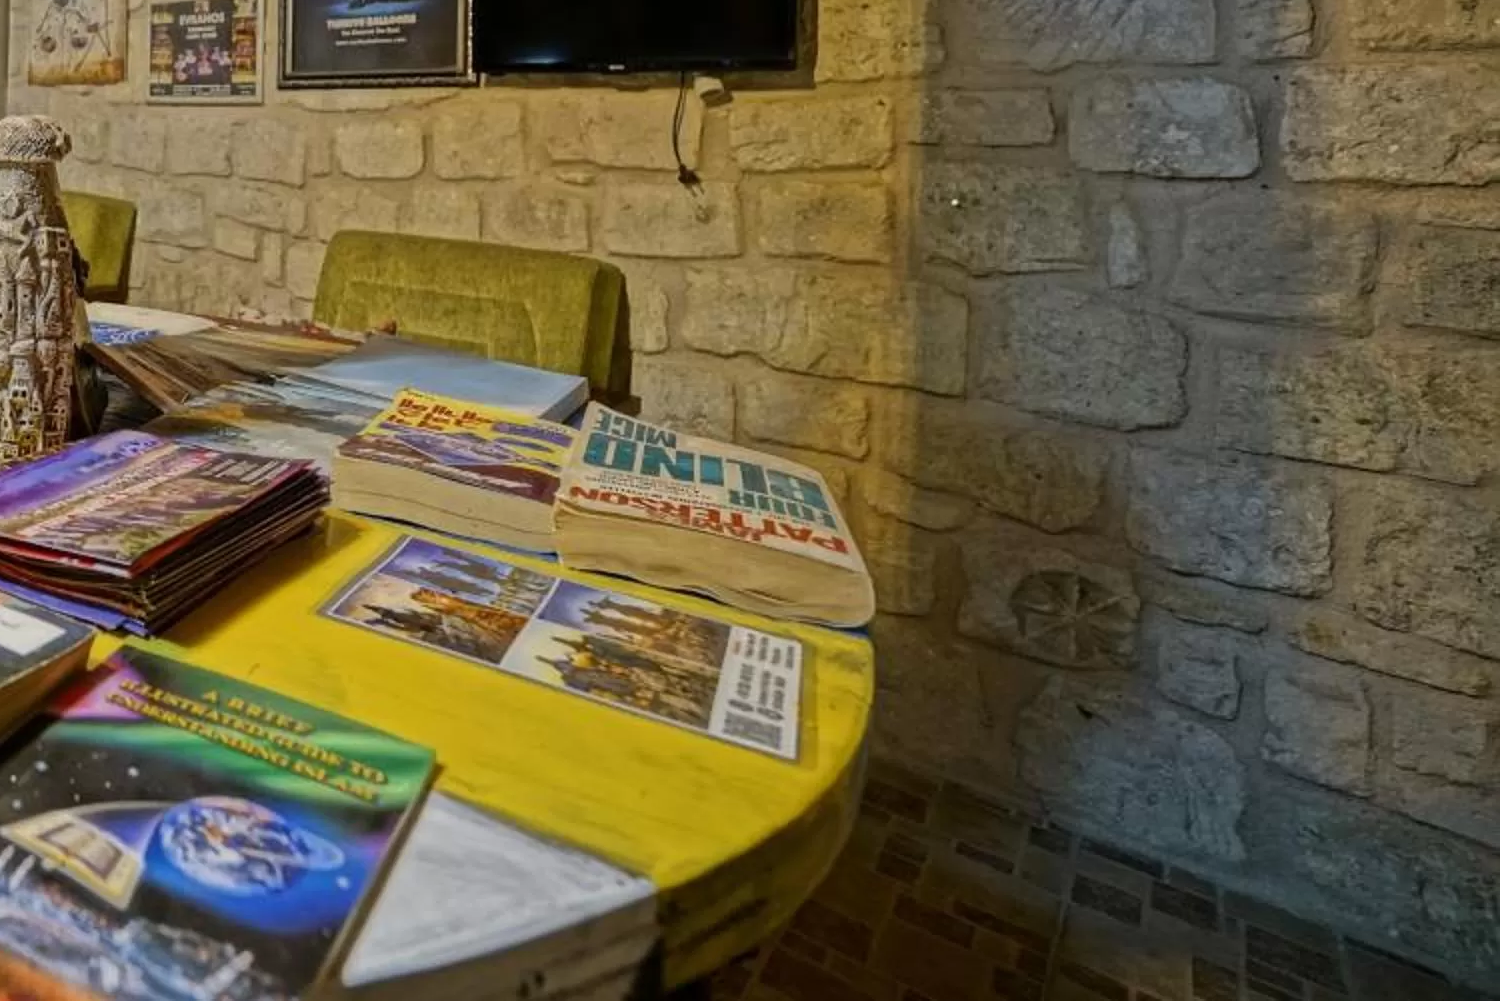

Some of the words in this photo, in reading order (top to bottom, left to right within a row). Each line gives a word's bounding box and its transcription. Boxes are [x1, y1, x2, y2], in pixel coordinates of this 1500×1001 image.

[592, 408, 677, 450] MICE
[582, 432, 829, 511] BLIND
[569, 486, 850, 554] PATTERSON
[118, 679, 265, 739] ILLUSTRATED
[349, 760, 390, 786] TO
[202, 687, 221, 704] A
[227, 696, 316, 735] BRIEF
[291, 761, 380, 805] ISLAM
